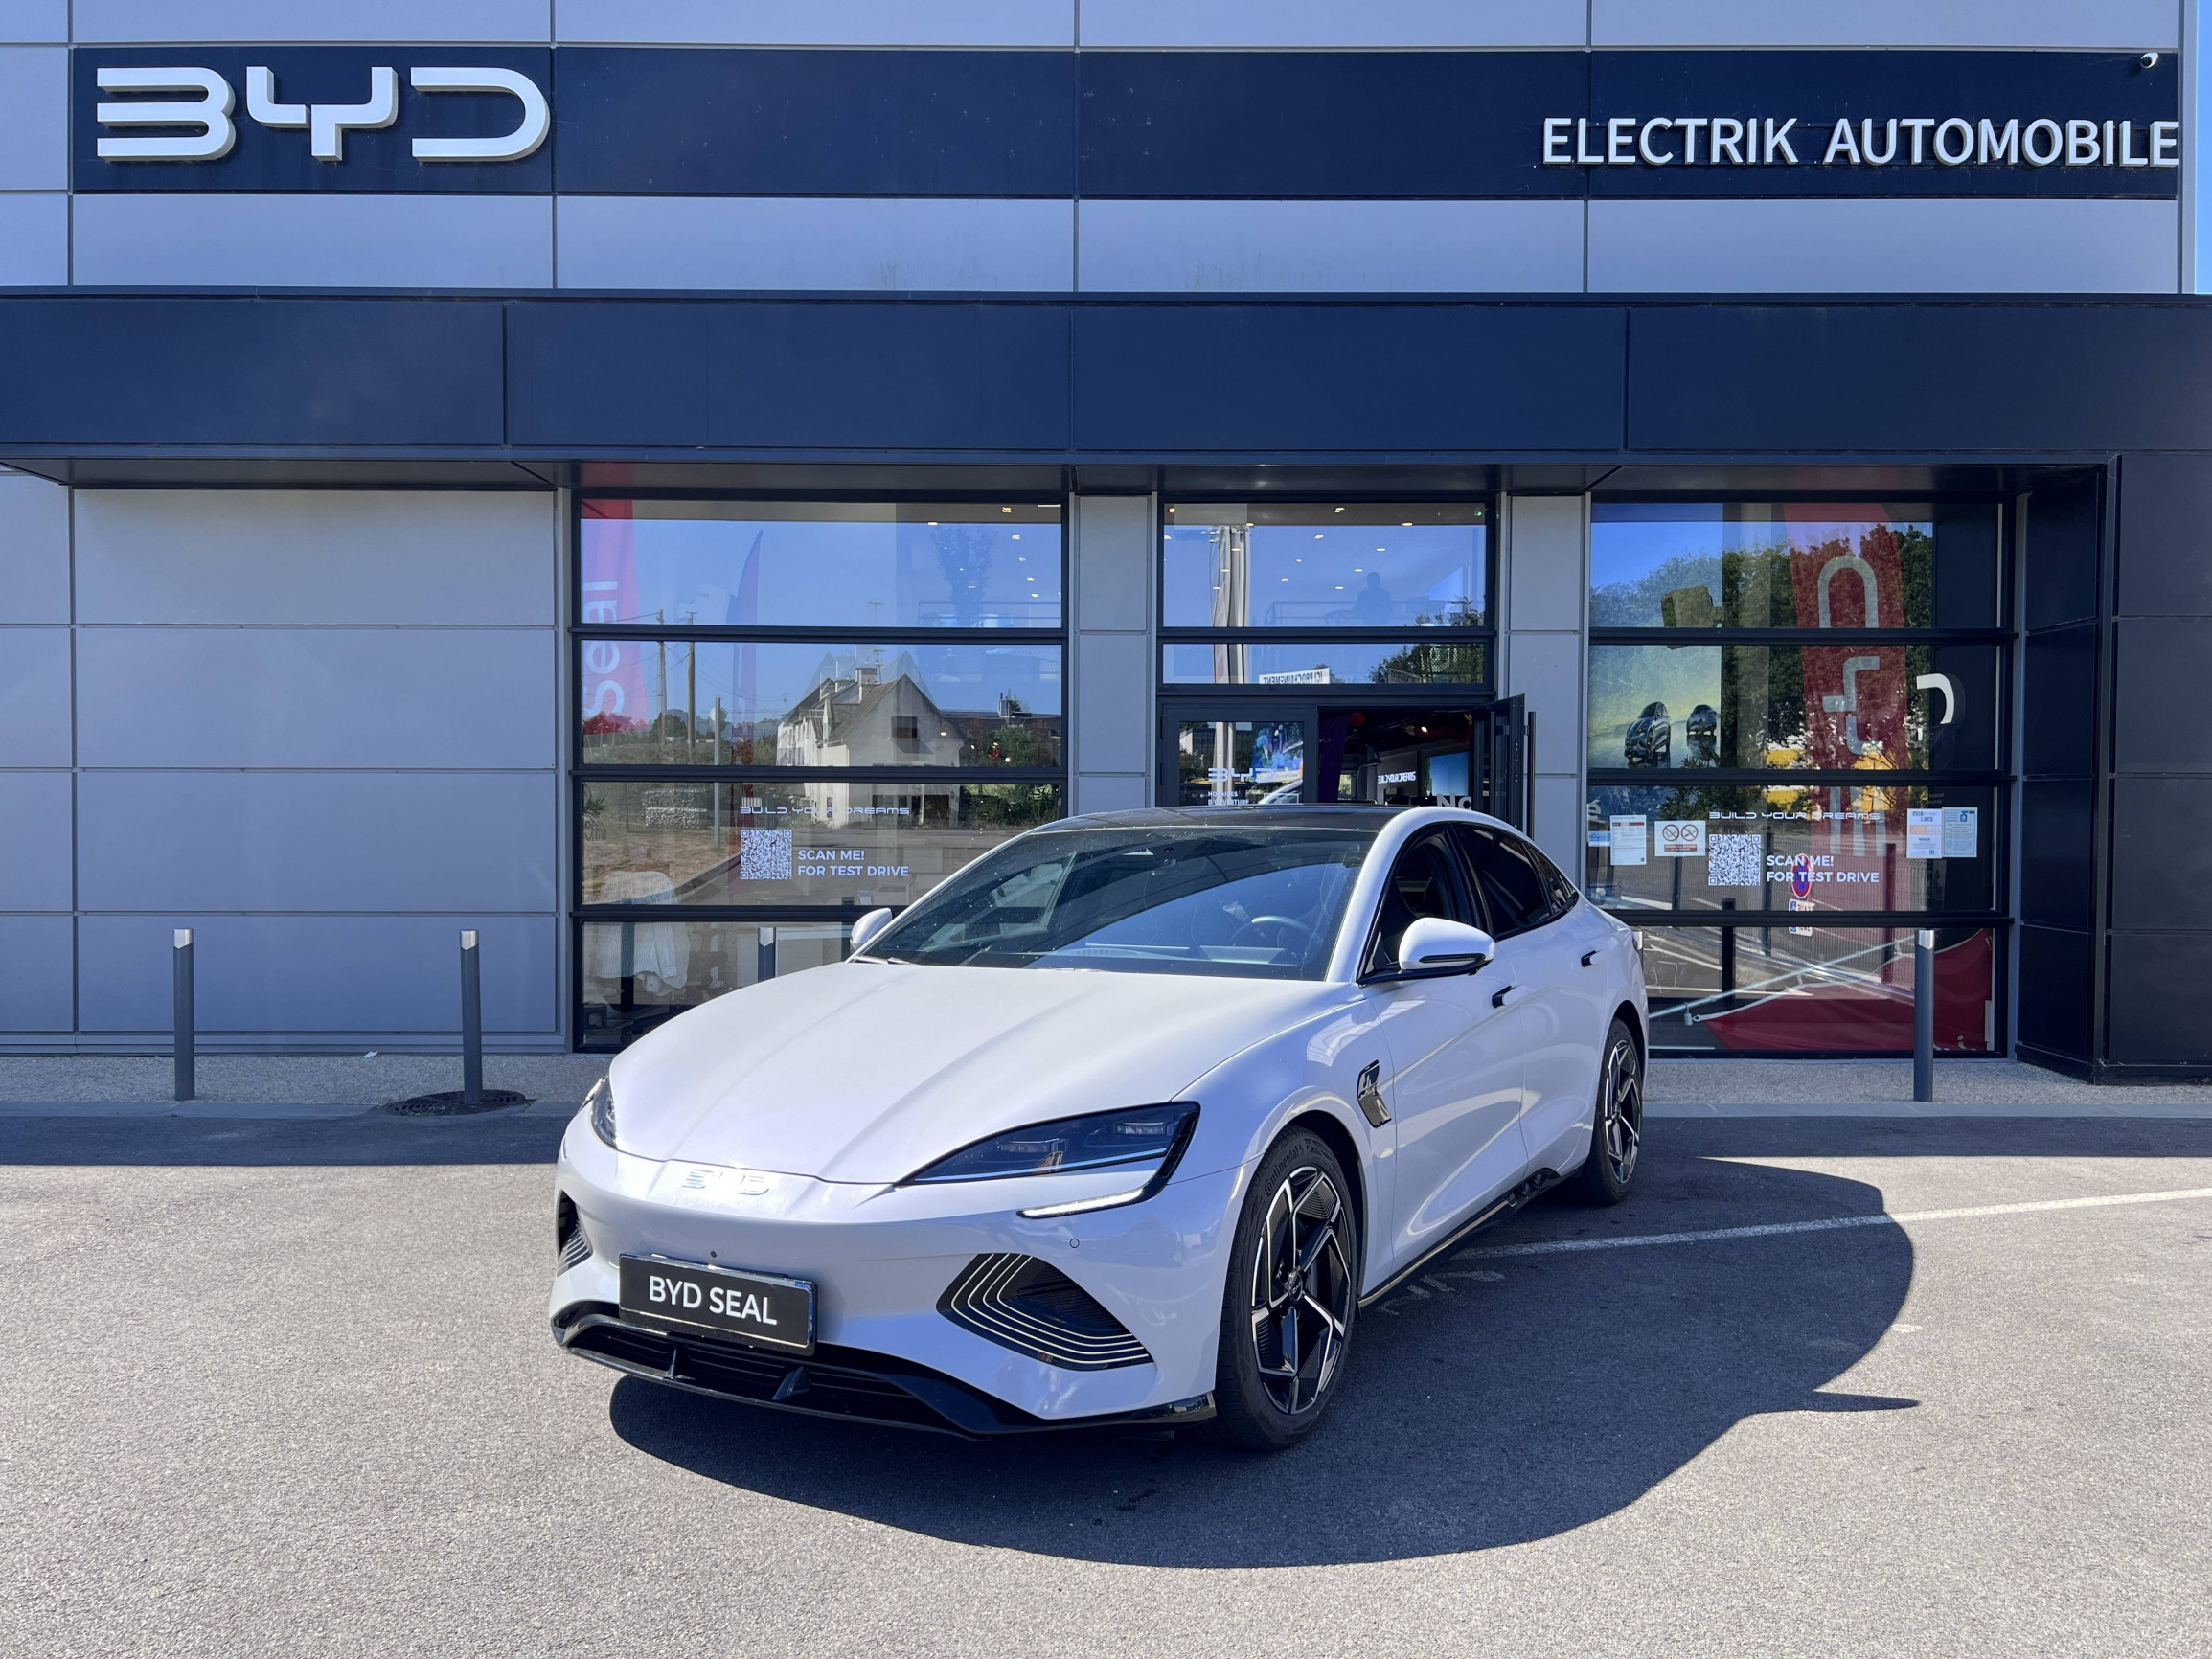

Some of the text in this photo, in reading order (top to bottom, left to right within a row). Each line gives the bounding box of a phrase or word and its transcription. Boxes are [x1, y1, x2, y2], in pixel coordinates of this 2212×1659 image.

[97, 66, 550, 161] BYD
[1542, 117, 2179, 168] ELECTRIK AUTOMOBILE
[1207, 767, 1275, 783] BYD
[1709, 811, 1757, 820] BUILD
[1761, 811, 1807, 820] YOUR
[797, 850, 865, 861] SCAN ME!
[1766, 855, 1835, 867] SCAN ME!
[797, 865, 909, 877] FOR TEST DRIVE
[1766, 871, 1880, 883] FOR TEST DRIVE
[1265, 1145, 1300, 1197] Continental
[681, 1168, 770, 1196] BD
[649, 1275, 778, 1327] BYD SEAL
